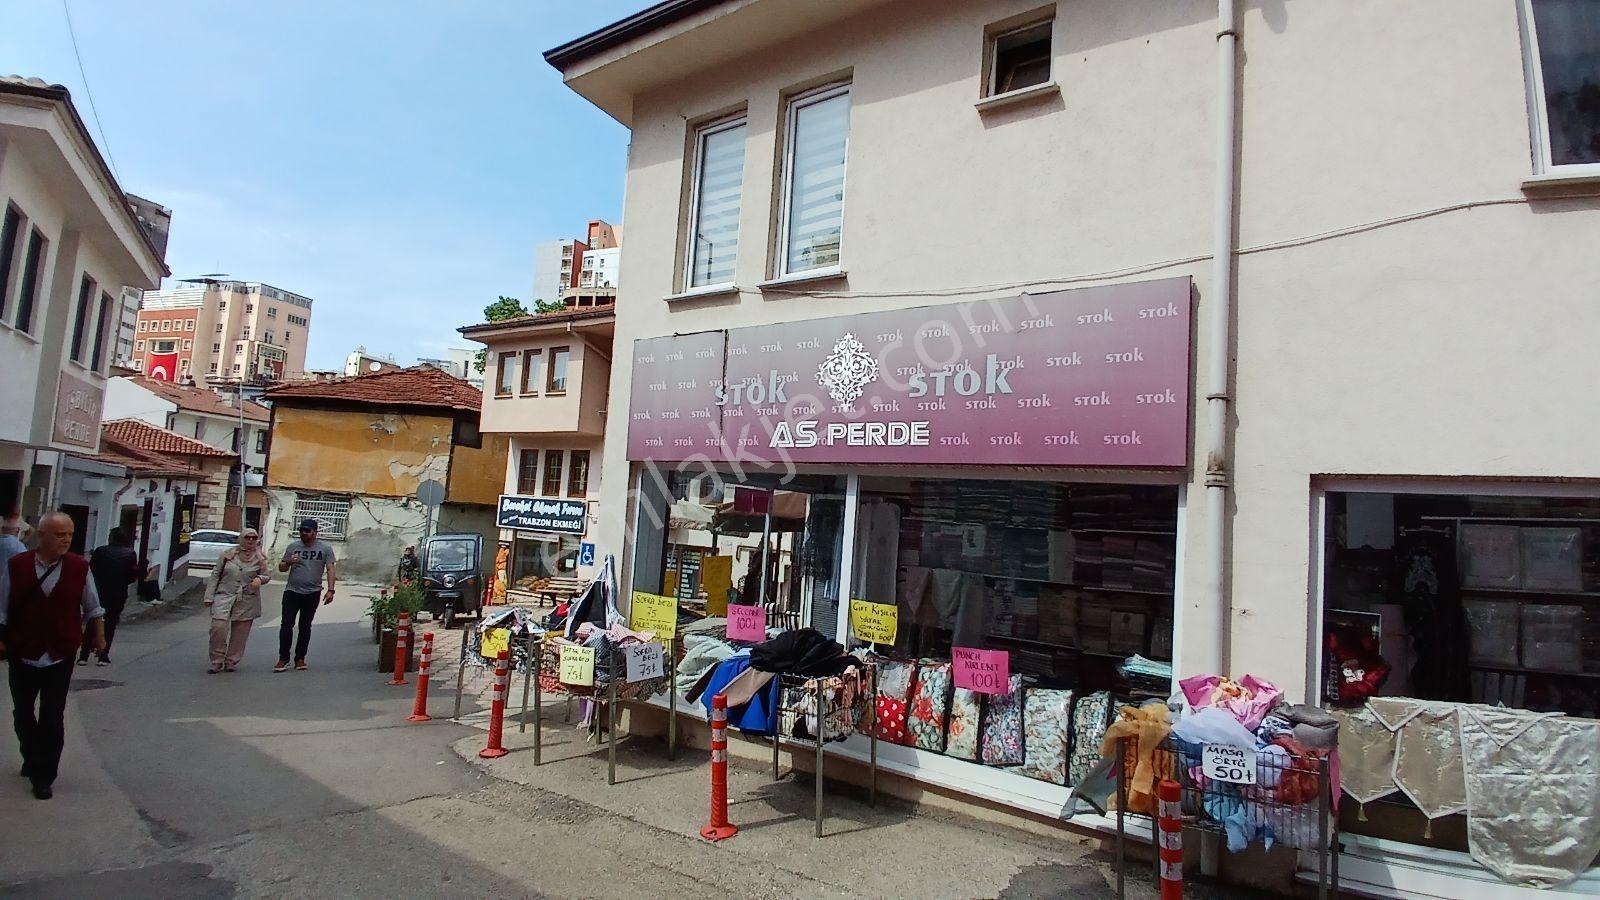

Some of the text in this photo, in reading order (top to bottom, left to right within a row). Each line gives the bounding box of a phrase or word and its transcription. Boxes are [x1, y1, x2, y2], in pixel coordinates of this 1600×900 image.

[769, 420, 930, 448] AS PERDE
[518, 516, 551, 527] TRABZON
[1206, 746, 1244, 758] MASA
